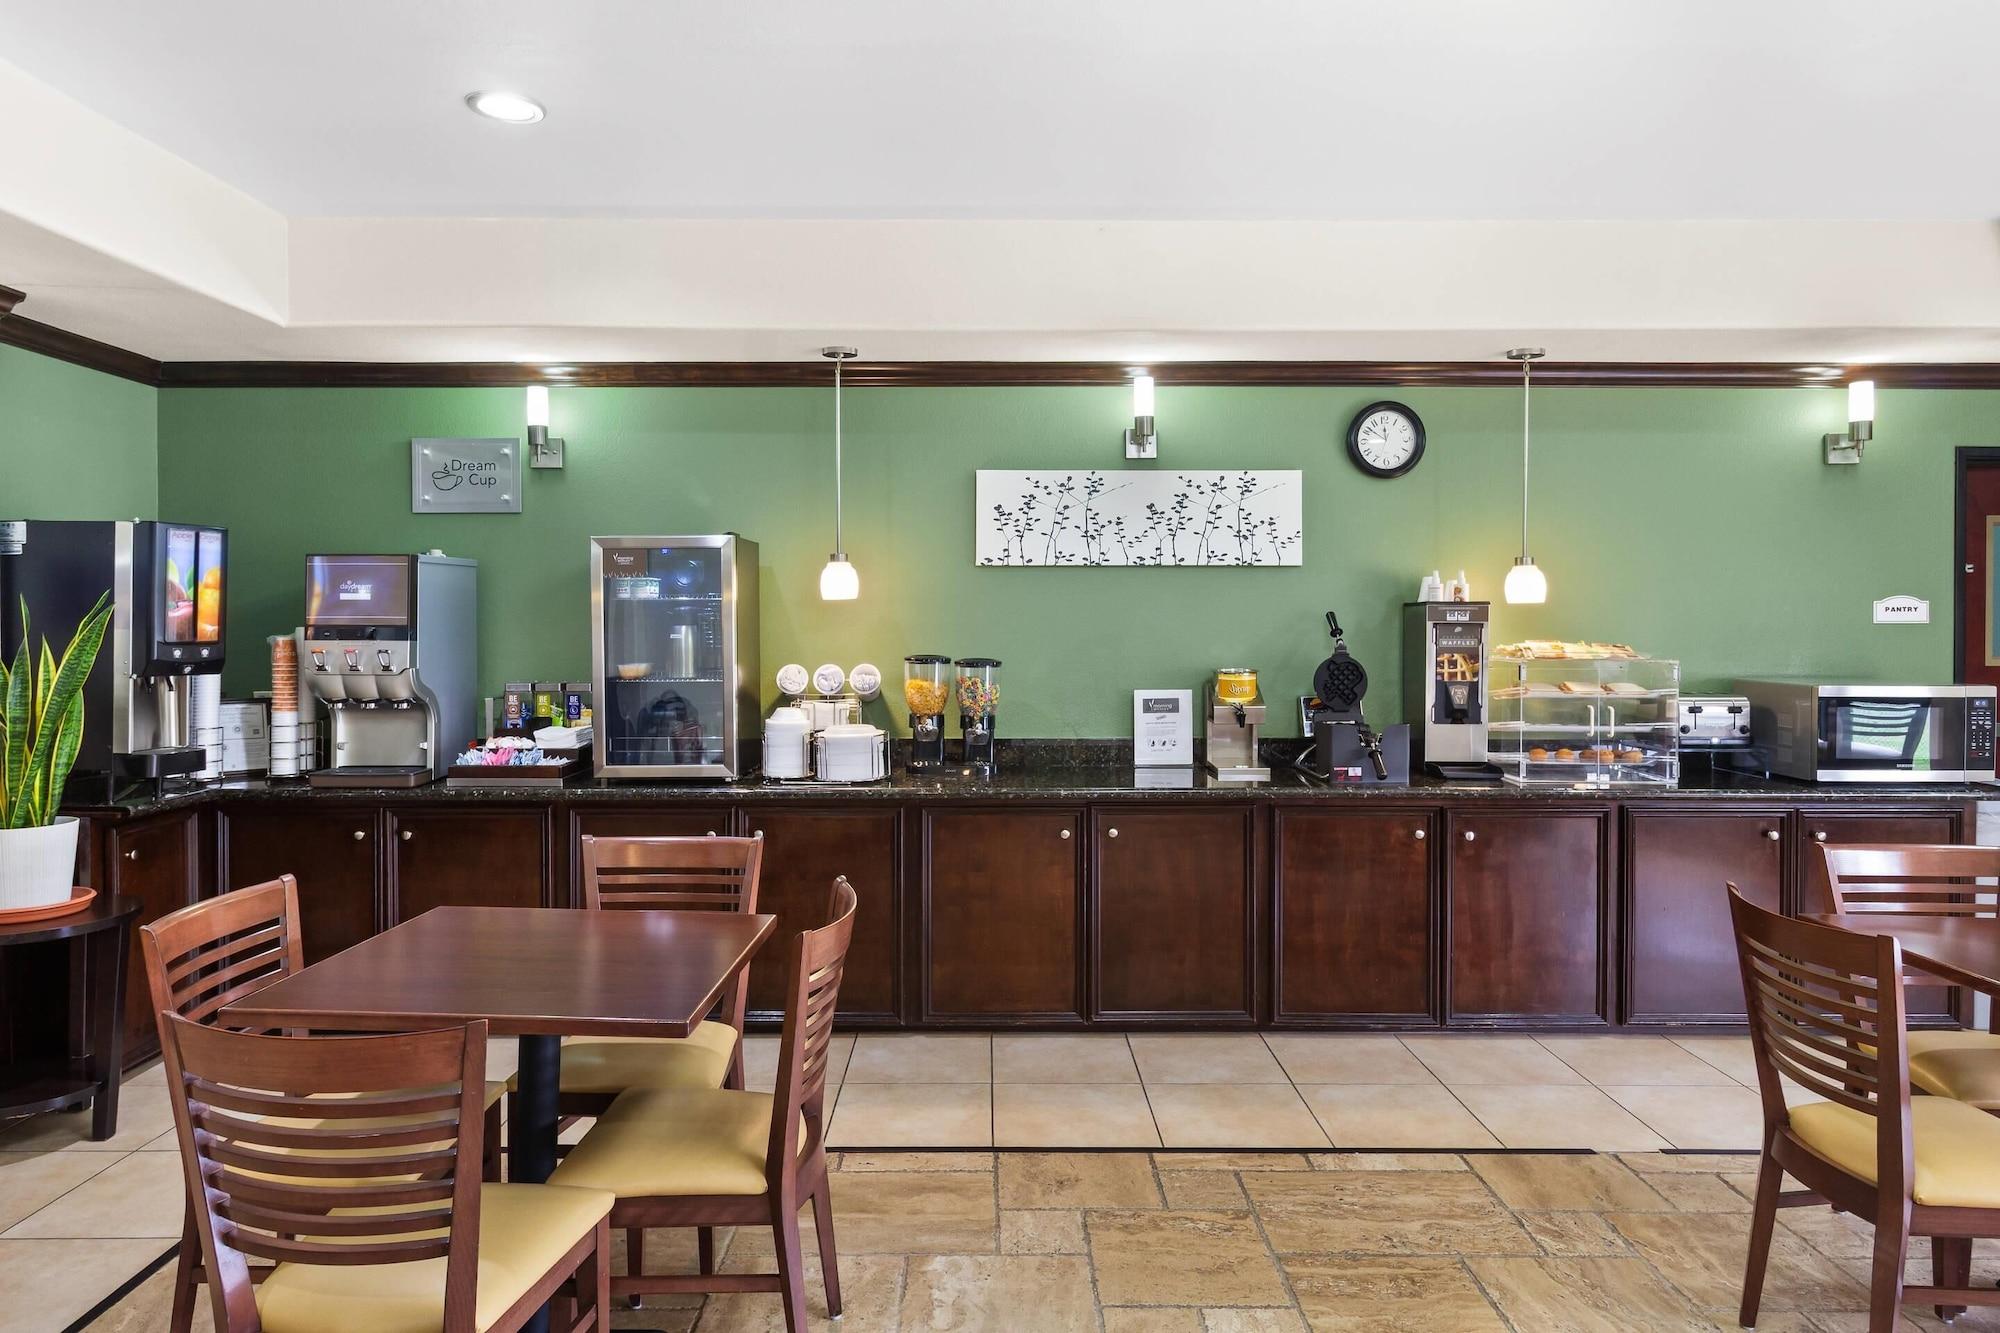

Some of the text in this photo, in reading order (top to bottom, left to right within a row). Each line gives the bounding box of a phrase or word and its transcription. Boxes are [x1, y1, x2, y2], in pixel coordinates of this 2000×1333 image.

[452, 459, 496, 471] Dream
[469, 473, 497, 488] Cup
[339, 583, 372, 591] daydream
[508, 694, 518, 702] BE
[539, 695, 548, 703] BE
[569, 695, 579, 703] BE
